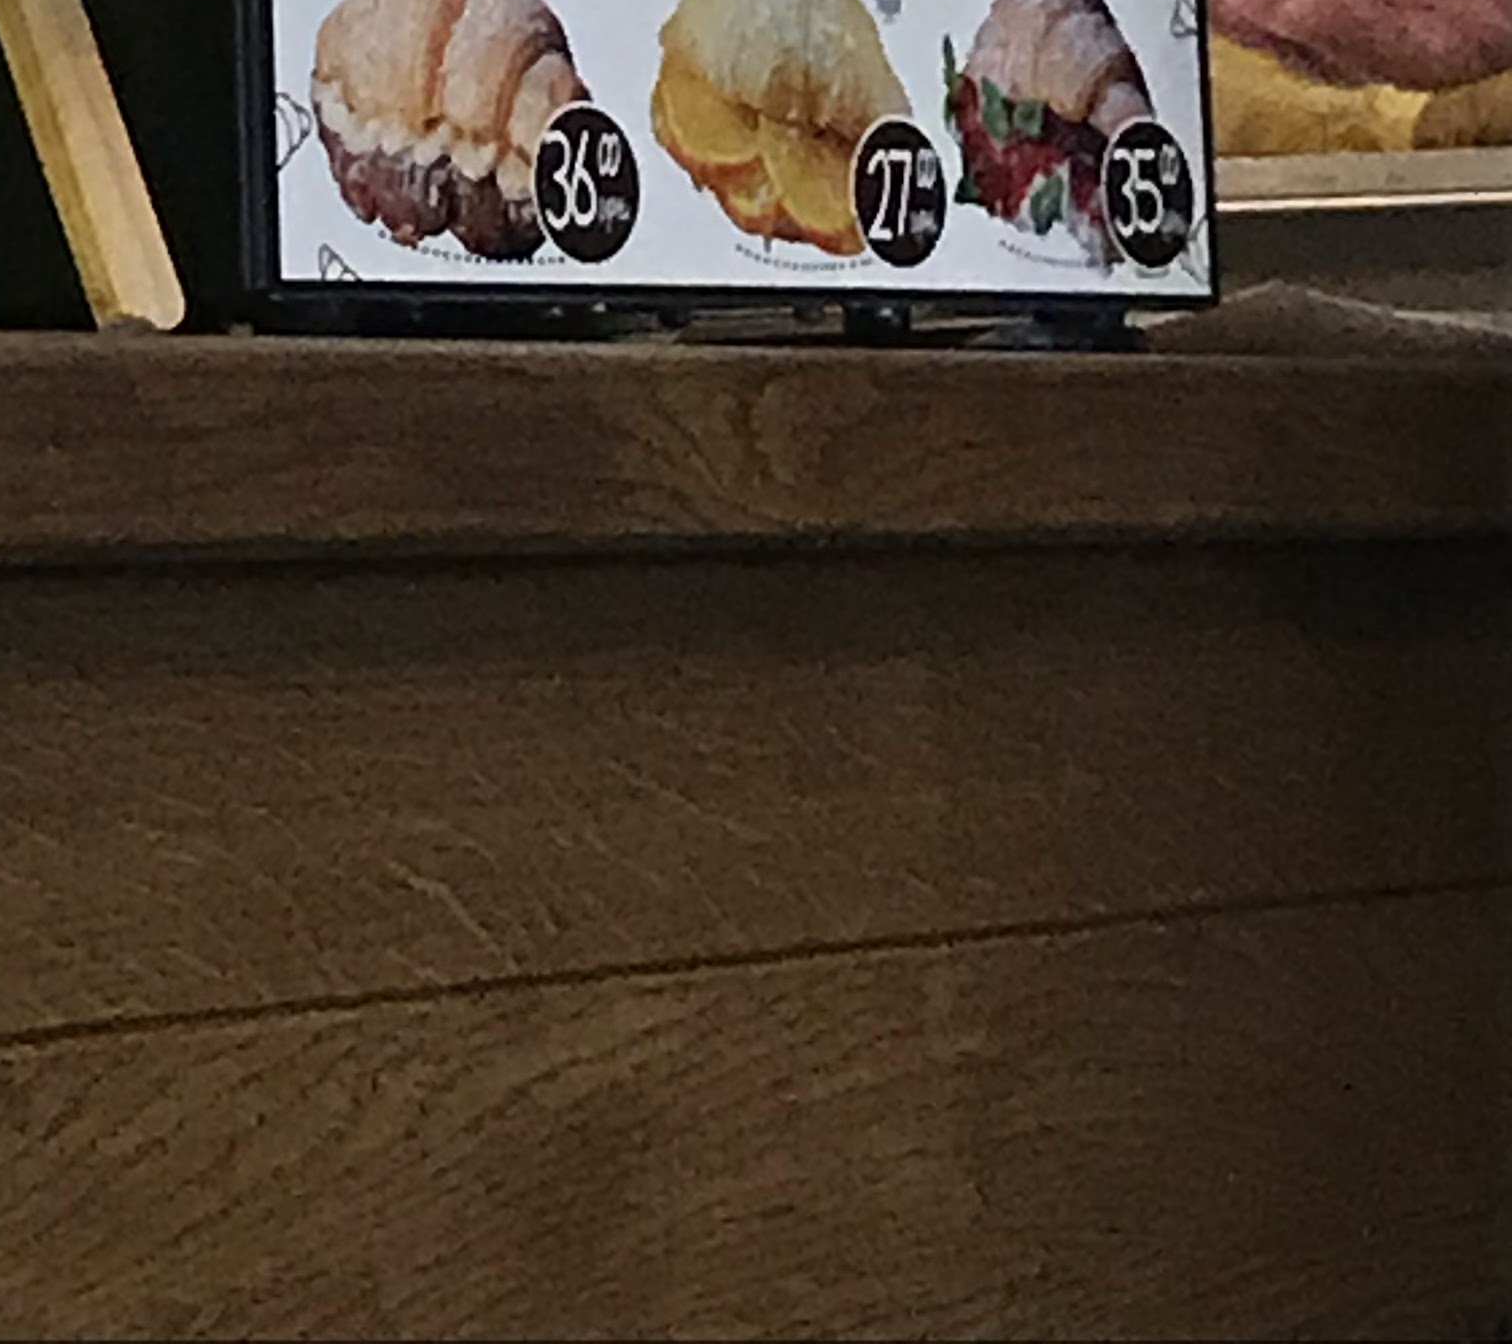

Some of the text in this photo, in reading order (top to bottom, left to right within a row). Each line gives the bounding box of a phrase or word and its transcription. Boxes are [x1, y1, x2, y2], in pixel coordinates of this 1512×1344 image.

[541, 129, 599, 228] 36
[867, 149, 913, 241] 27
[1113, 148, 1166, 235] 35
